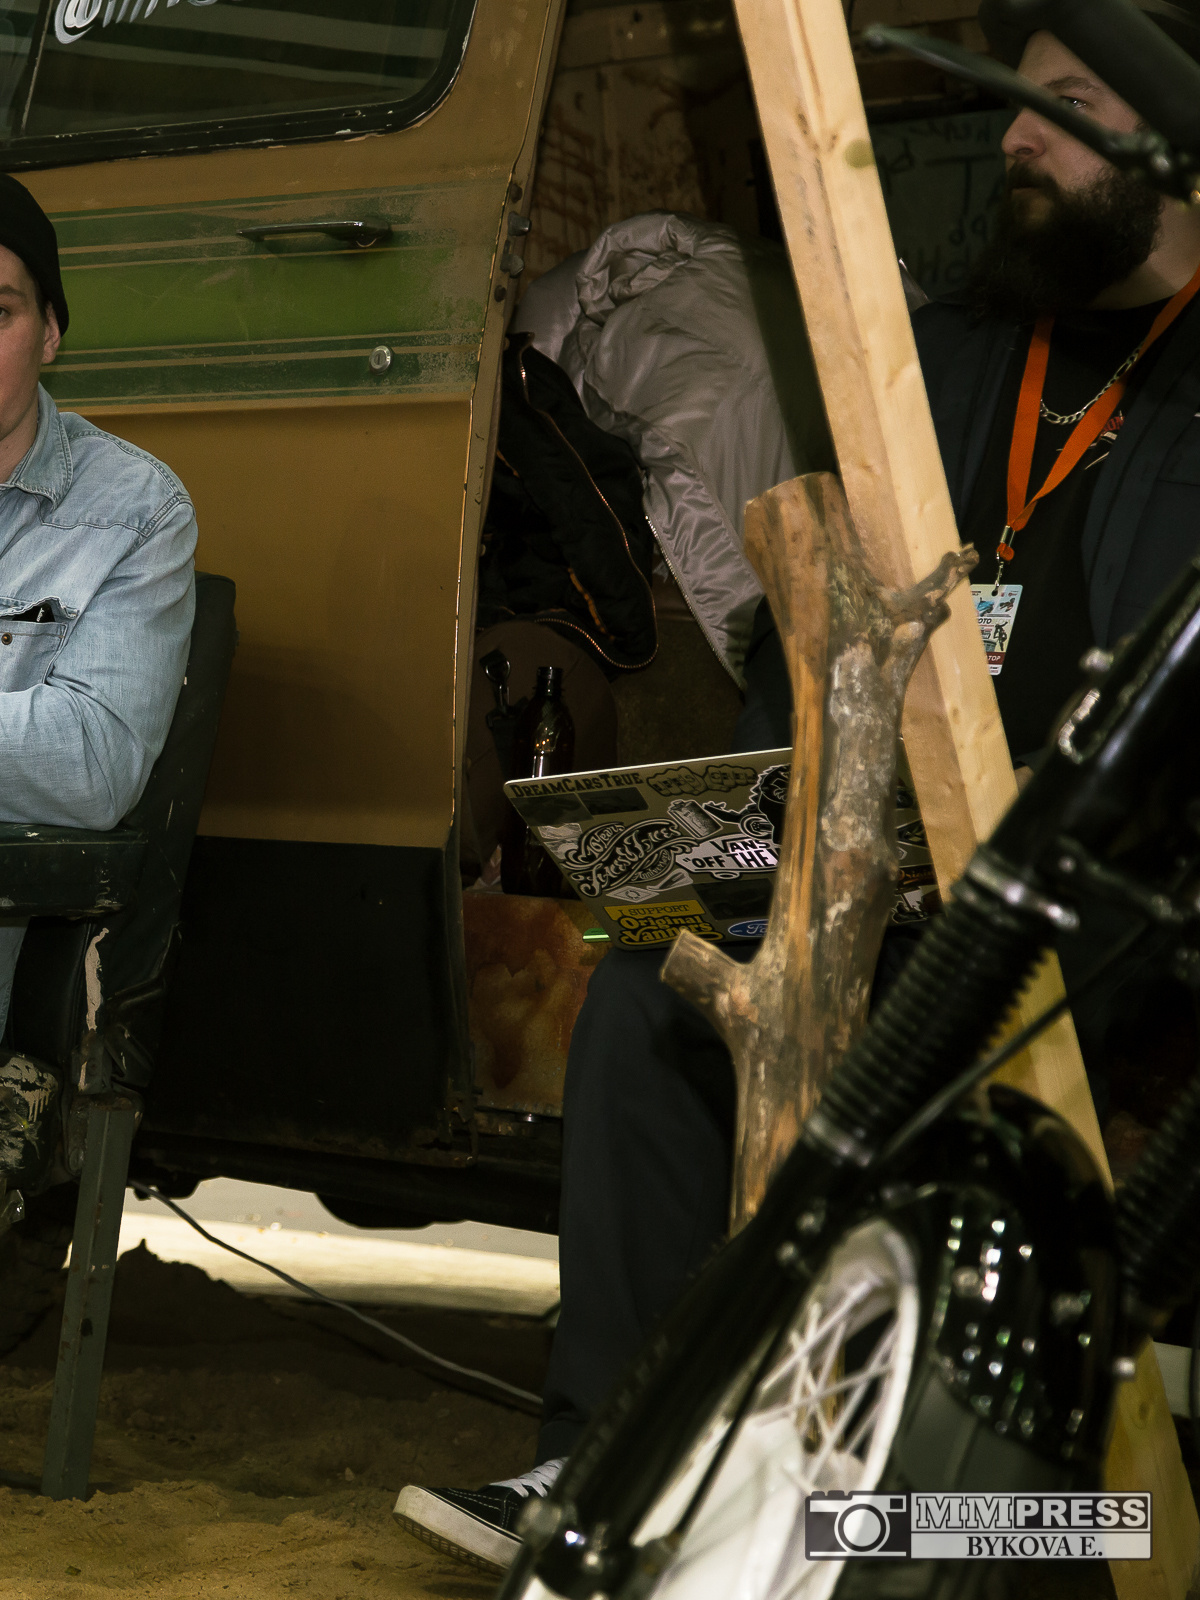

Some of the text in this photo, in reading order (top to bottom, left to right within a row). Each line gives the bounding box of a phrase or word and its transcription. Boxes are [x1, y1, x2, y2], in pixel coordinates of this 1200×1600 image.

[710, 838, 771, 853] VANS
[728, 850, 774, 869] THE
[629, 904, 690, 917] SUPPORT
[619, 915, 702, 931] Original
